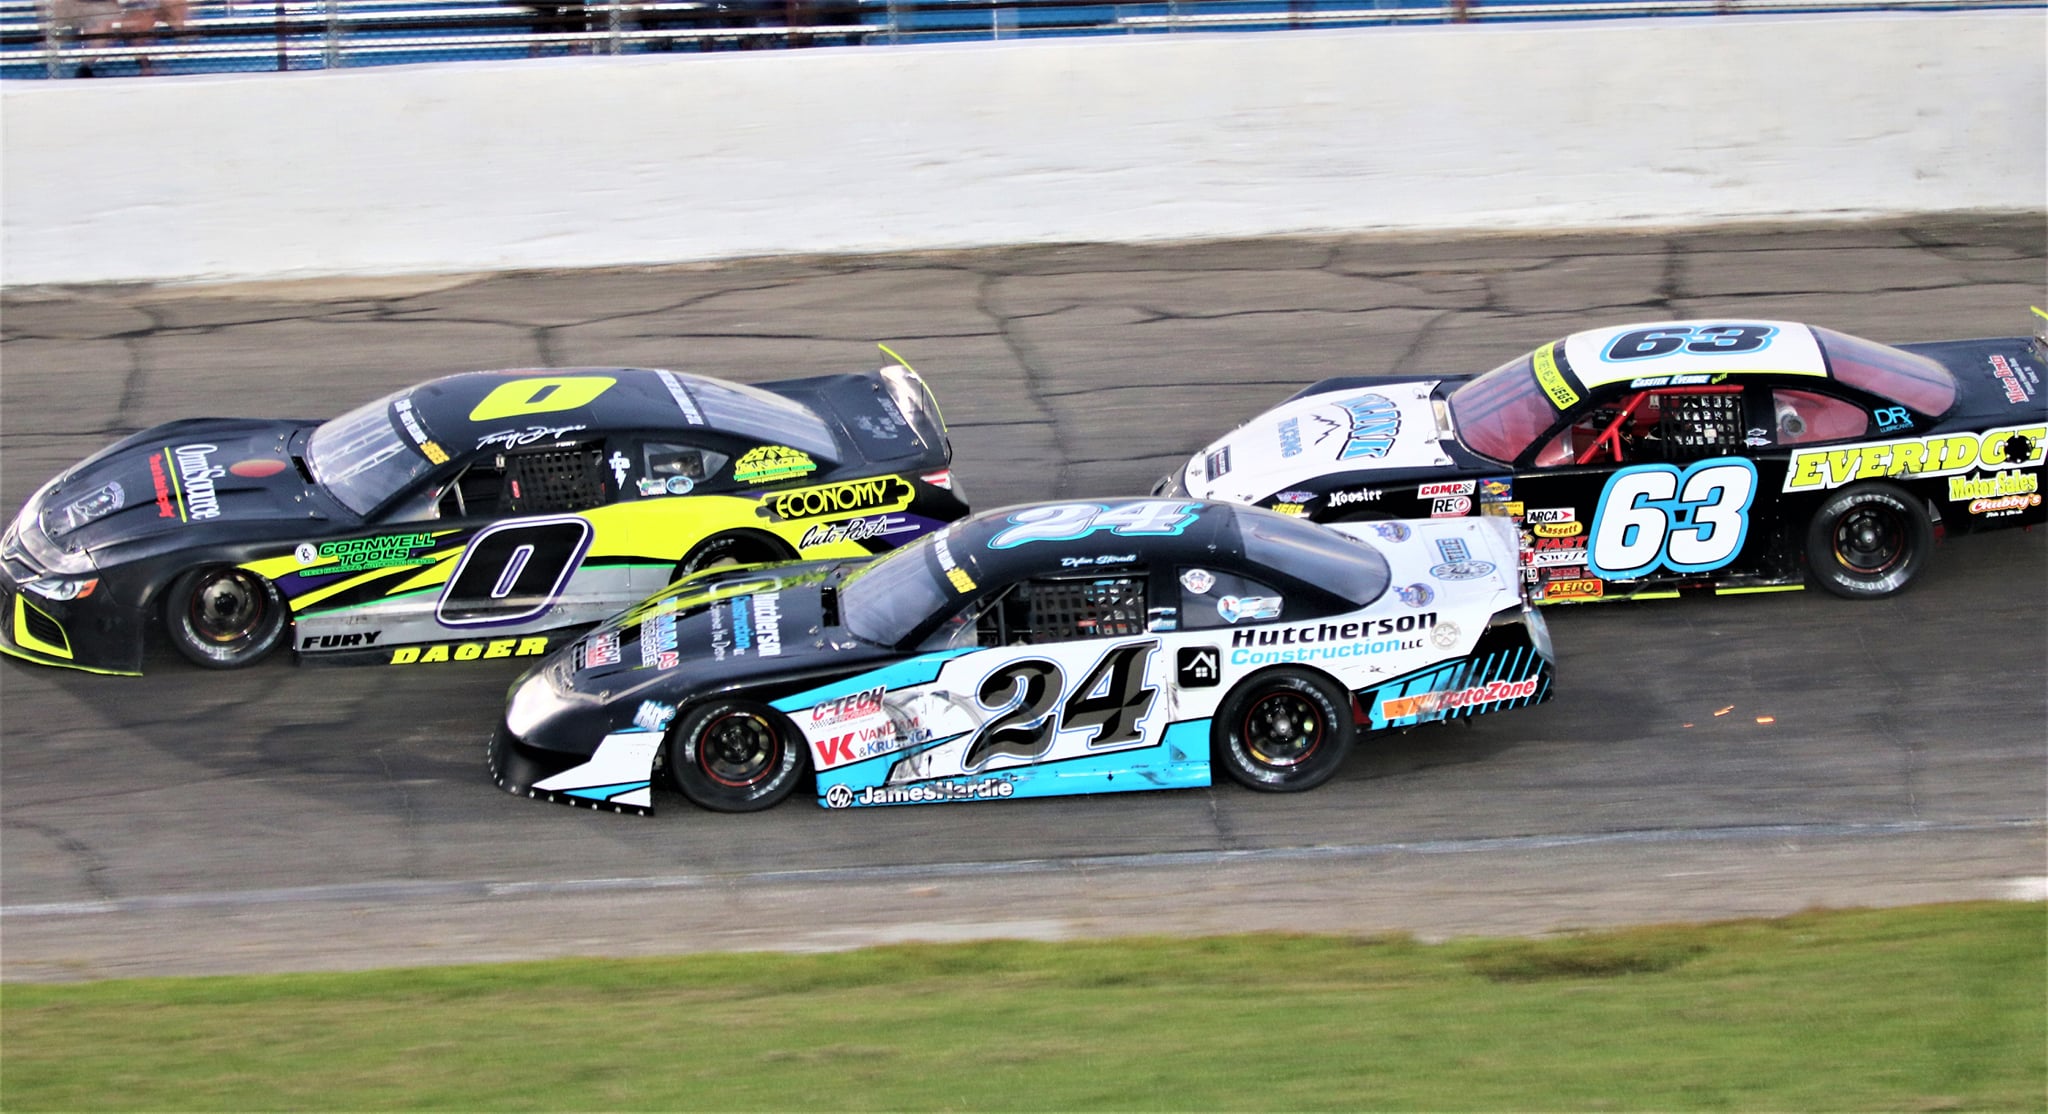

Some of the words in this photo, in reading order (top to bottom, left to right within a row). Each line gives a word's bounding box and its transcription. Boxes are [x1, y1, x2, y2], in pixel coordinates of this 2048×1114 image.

[1600, 325, 1780, 362] 63
[469, 377, 617, 421] 0
[476, 429, 515, 450] Tony
[518, 424, 586, 444] Dager
[175, 443, 226, 520] OmniSource
[1327, 488, 1382, 507] Hoosier
[1421, 483, 1463, 496] COMP
[1949, 472, 1997, 501] Motor
[1997, 469, 2038, 495] Sales
[776, 480, 887, 520] ECONOMY
[1528, 510, 1559, 522] ARCA
[1969, 493, 2042, 514] Chubby's
[798, 525, 836, 550] Auto
[838, 516, 887, 542] Parts
[987, 501, 1204, 549] 24
[1587, 456, 1758, 580] 63
[319, 533, 436, 557] CORNWELL
[338, 548, 410, 567] TOOLS
[1535, 536, 1588, 550] FAST
[435, 513, 594, 629] 0
[1550, 582, 1594, 593] AERO
[731, 596, 753, 649] Construction
[753, 591, 782, 657] Hutcherson
[1231, 611, 1438, 648] Hutcherson
[302, 631, 382, 649] FURY
[390, 637, 549, 664] DAGER
[1231, 639, 1401, 665] Construction
[1401, 638, 1423, 651] LLC
[812, 686, 885, 721] C-TECH
[961, 637, 1162, 775] 24
[815, 732, 856, 766] VK
[860, 777, 1014, 805] JamesHardie
